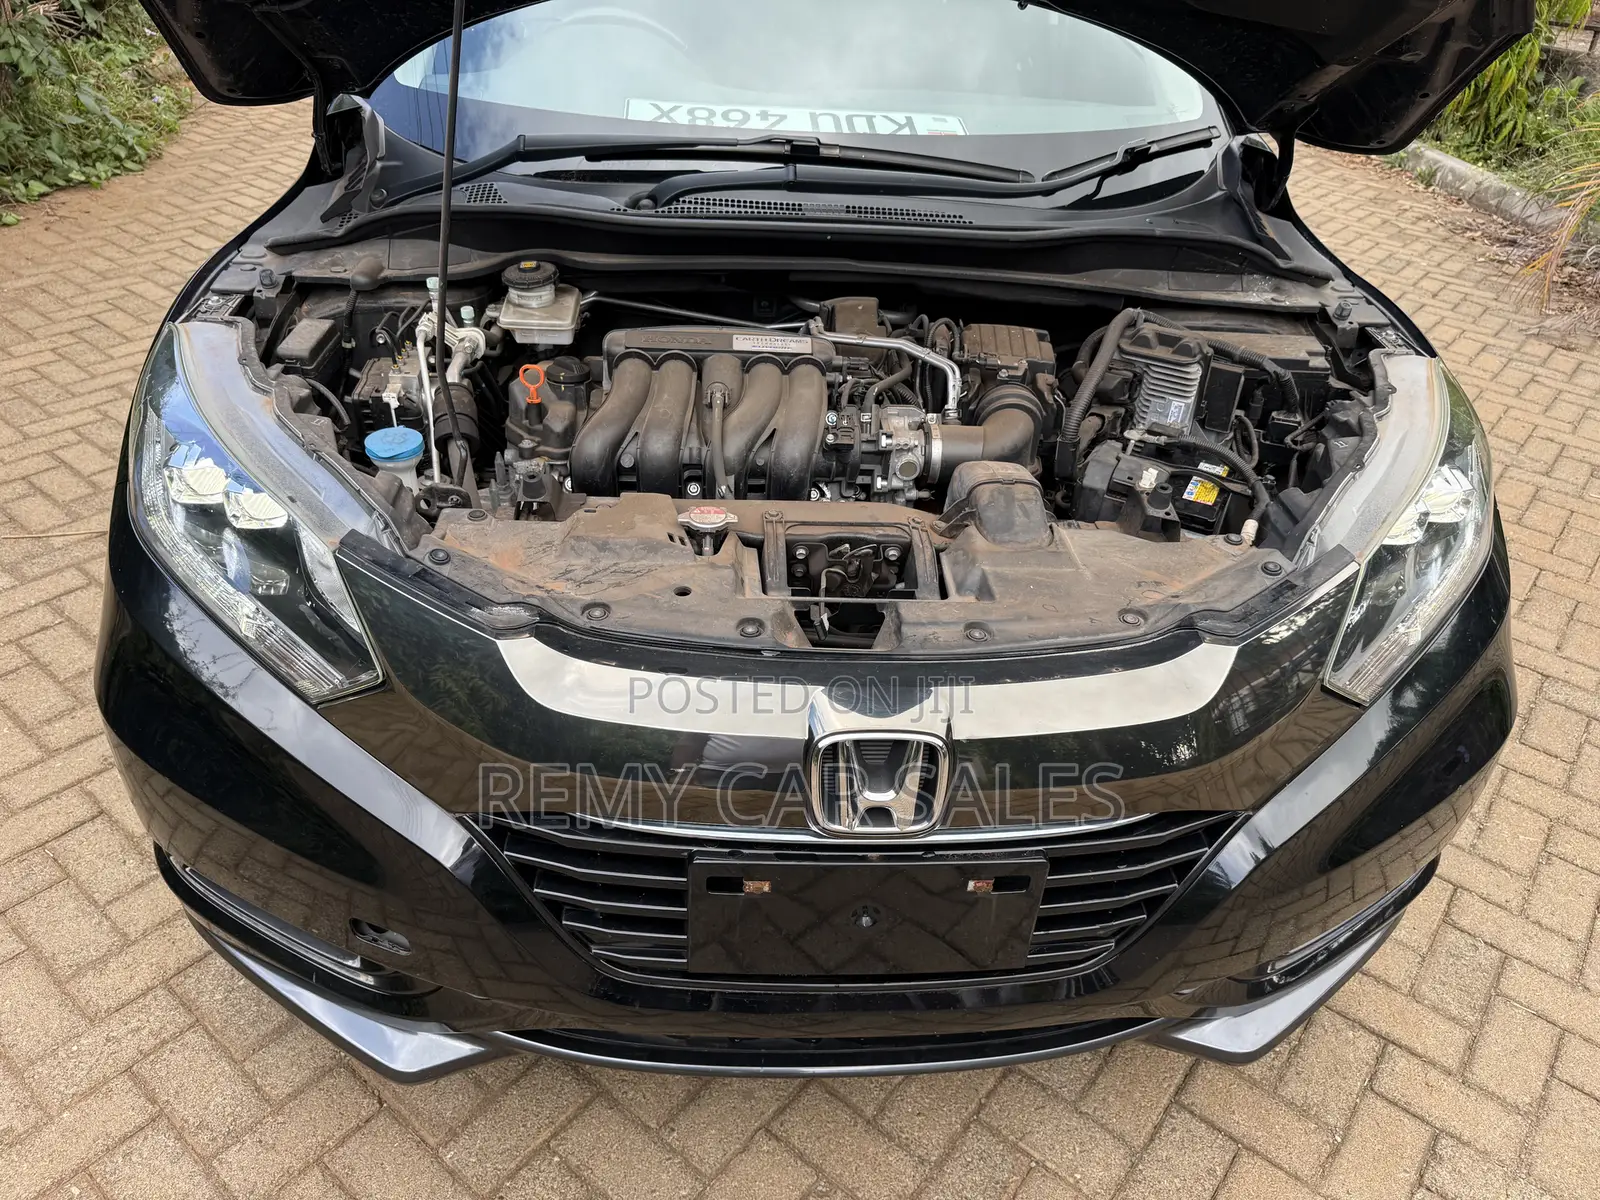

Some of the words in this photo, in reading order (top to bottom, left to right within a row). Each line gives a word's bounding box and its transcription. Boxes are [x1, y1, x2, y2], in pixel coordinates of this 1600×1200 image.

[649, 102, 789, 129] 468X
[809, 111, 918, 136] KDU
[641, 335, 712, 345] HONDA
